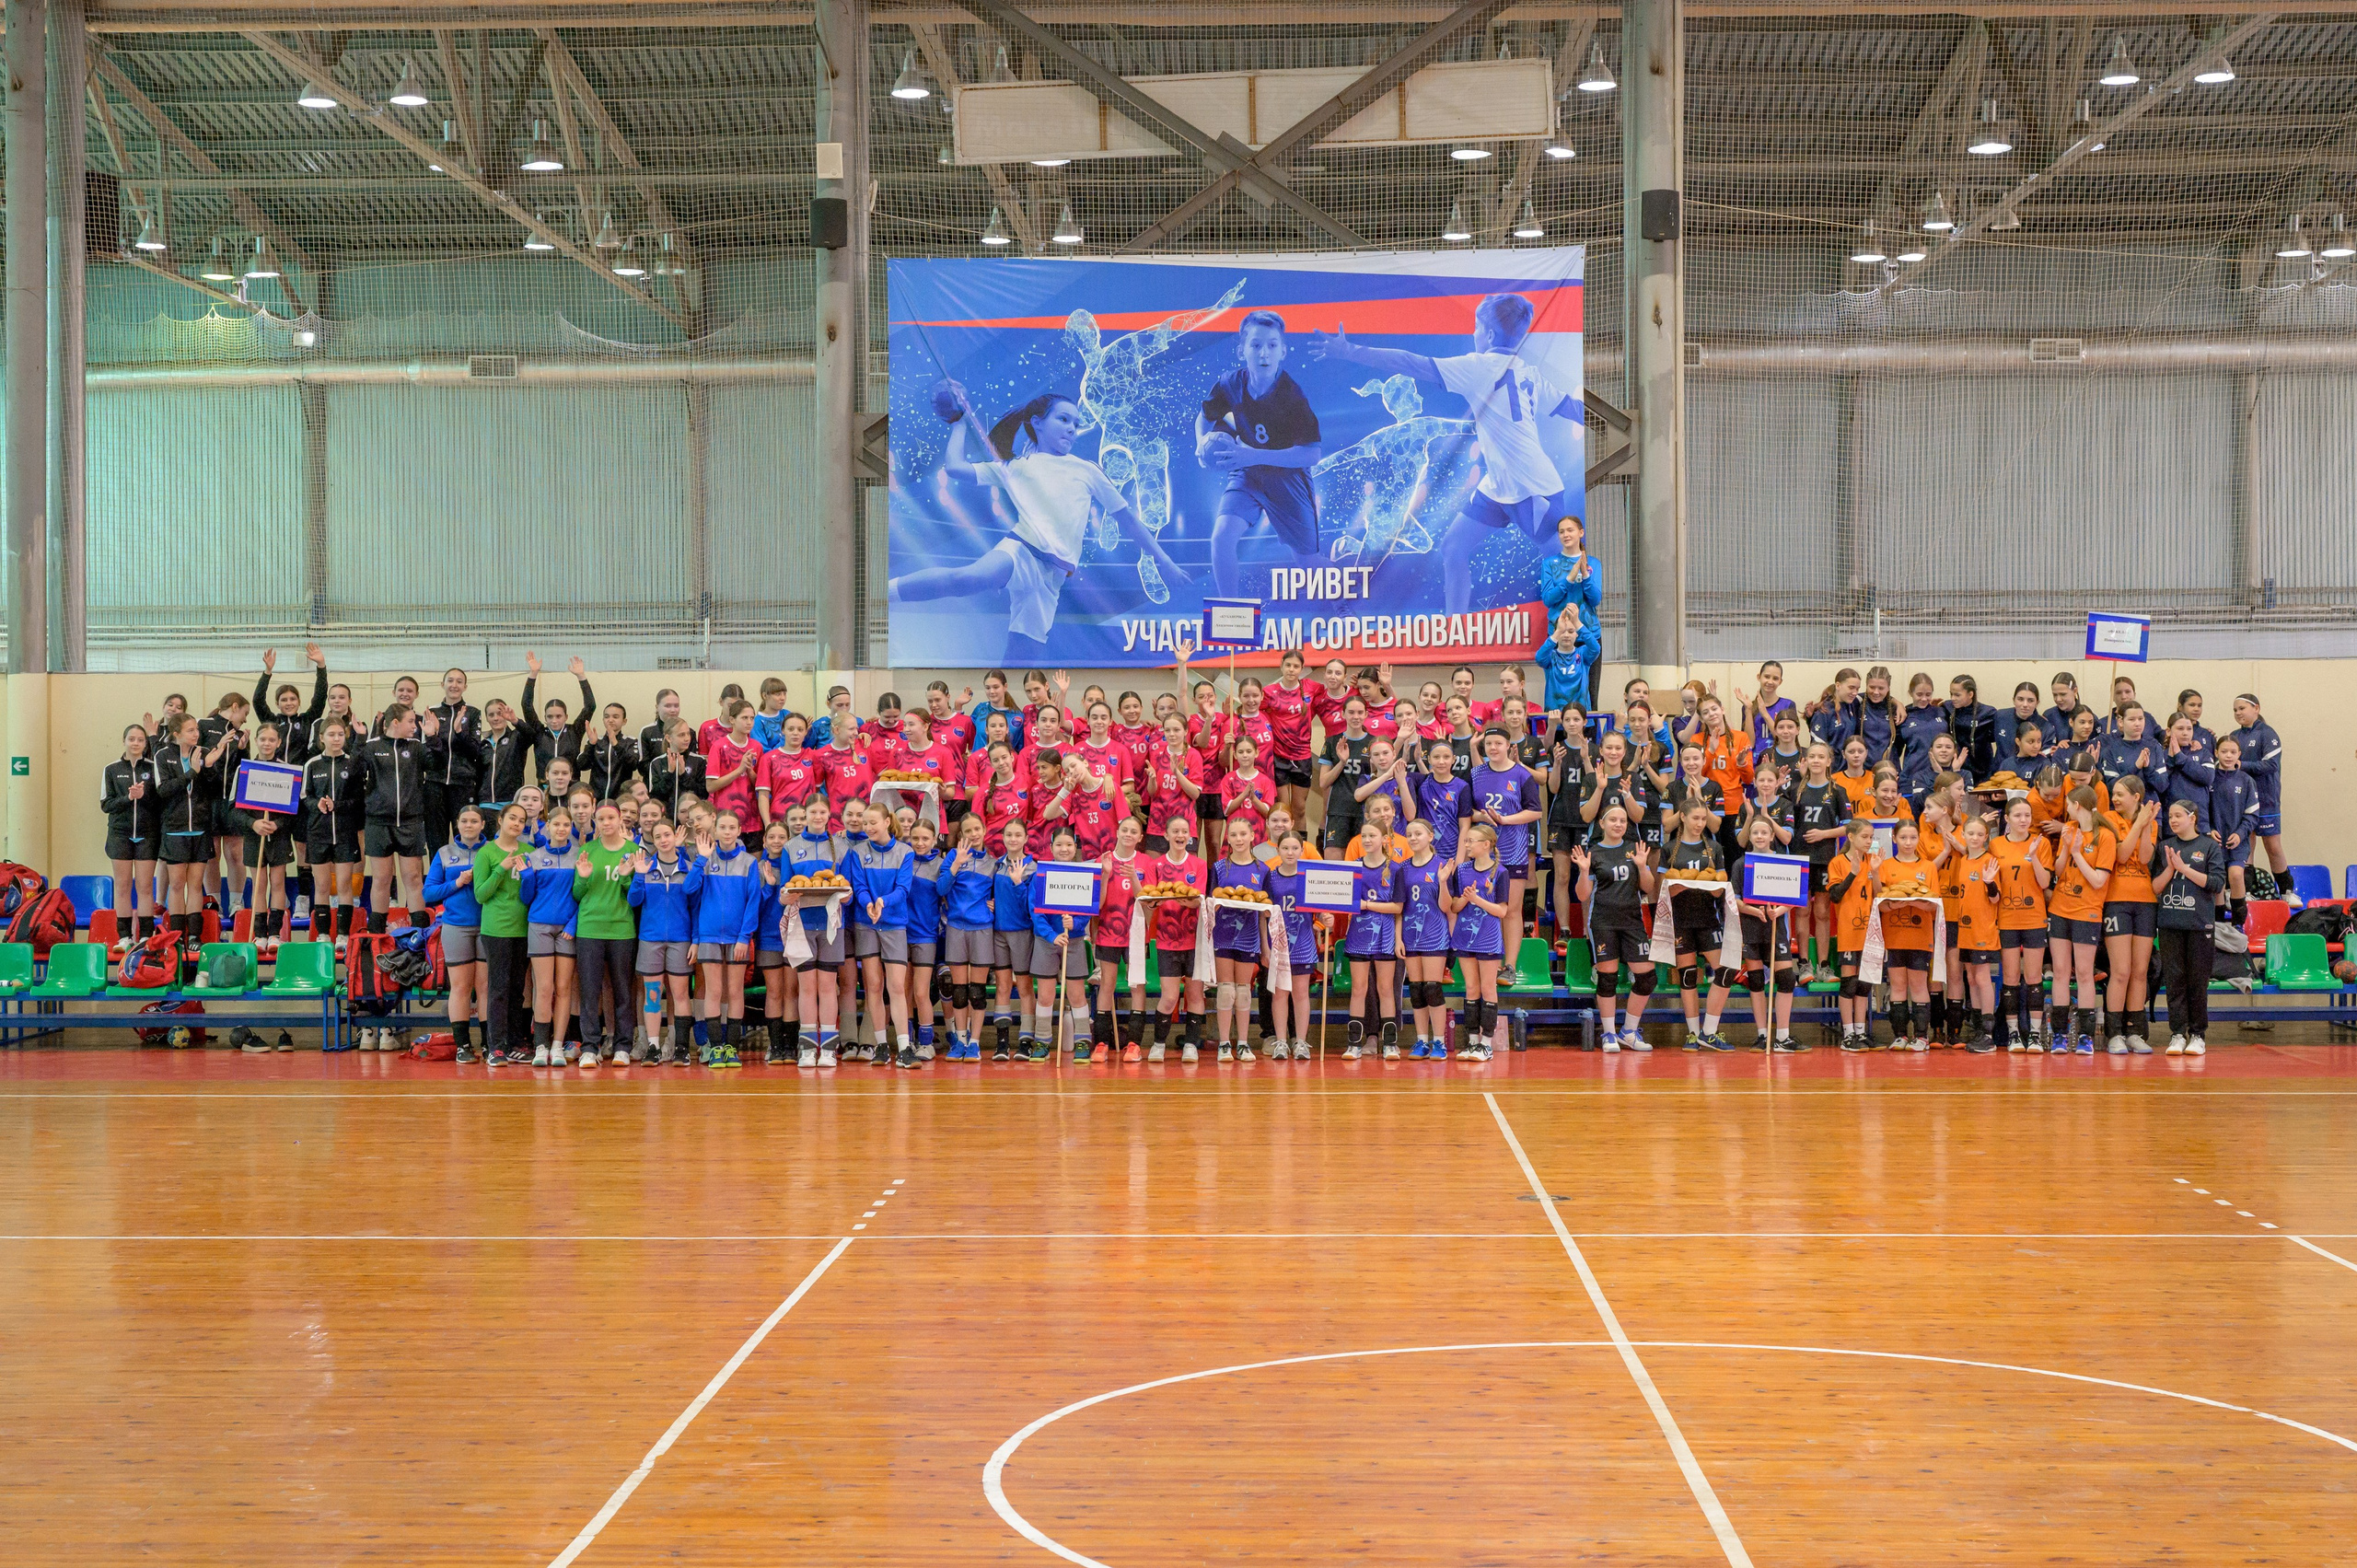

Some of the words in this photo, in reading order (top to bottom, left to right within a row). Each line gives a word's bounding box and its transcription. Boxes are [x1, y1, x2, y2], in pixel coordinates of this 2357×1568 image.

[1255, 424, 1270, 444] 8
[1271, 566, 1373, 600] ПРИВЕТ
[1121, 618, 1303, 652] УЧАСТАМ
[1310, 605, 1530, 649] СОРЕВНОВАНИЙ!
[1561, 665, 1575, 676] 12
[1288, 703, 1303, 714] 11
[1370, 719, 1379, 729] 3
[884, 738, 897, 749] 52
[940, 734, 947, 745] 5
[1257, 730, 1271, 743] 15
[1130, 742, 1147, 754] 10
[1095, 764, 1106, 775] 38
[1343, 759, 1362, 774] 55
[1712, 755, 1726, 770] 16
[790, 768, 804, 780] 90
[843, 765, 856, 778] 55
[1567, 767, 1582, 784] 21
[250, 780, 284, 789] АСТРАХАНЬ
[1162, 772, 1177, 790] 35
[1006, 801, 1020, 815] 23
[1484, 793, 1504, 809] 22
[1087, 811, 1099, 824] 33
[1804, 806, 1822, 822] 27
[604, 865, 621, 882] 16
[1611, 865, 1630, 881] 19
[2012, 865, 2021, 881] 7
[1048, 883, 1090, 891] ВОЛГОГРАД
[1121, 878, 1131, 890] 6
[1367, 889, 1377, 901] 9
[1411, 884, 1421, 901] 8
[1860, 885, 1868, 900] 4
[2163, 884, 2196, 905] delo
[1282, 895, 1296, 912] 12
[2104, 916, 2119, 933] 21
[1637, 942, 1651, 956] 19
[1779, 943, 1788, 954] 5
